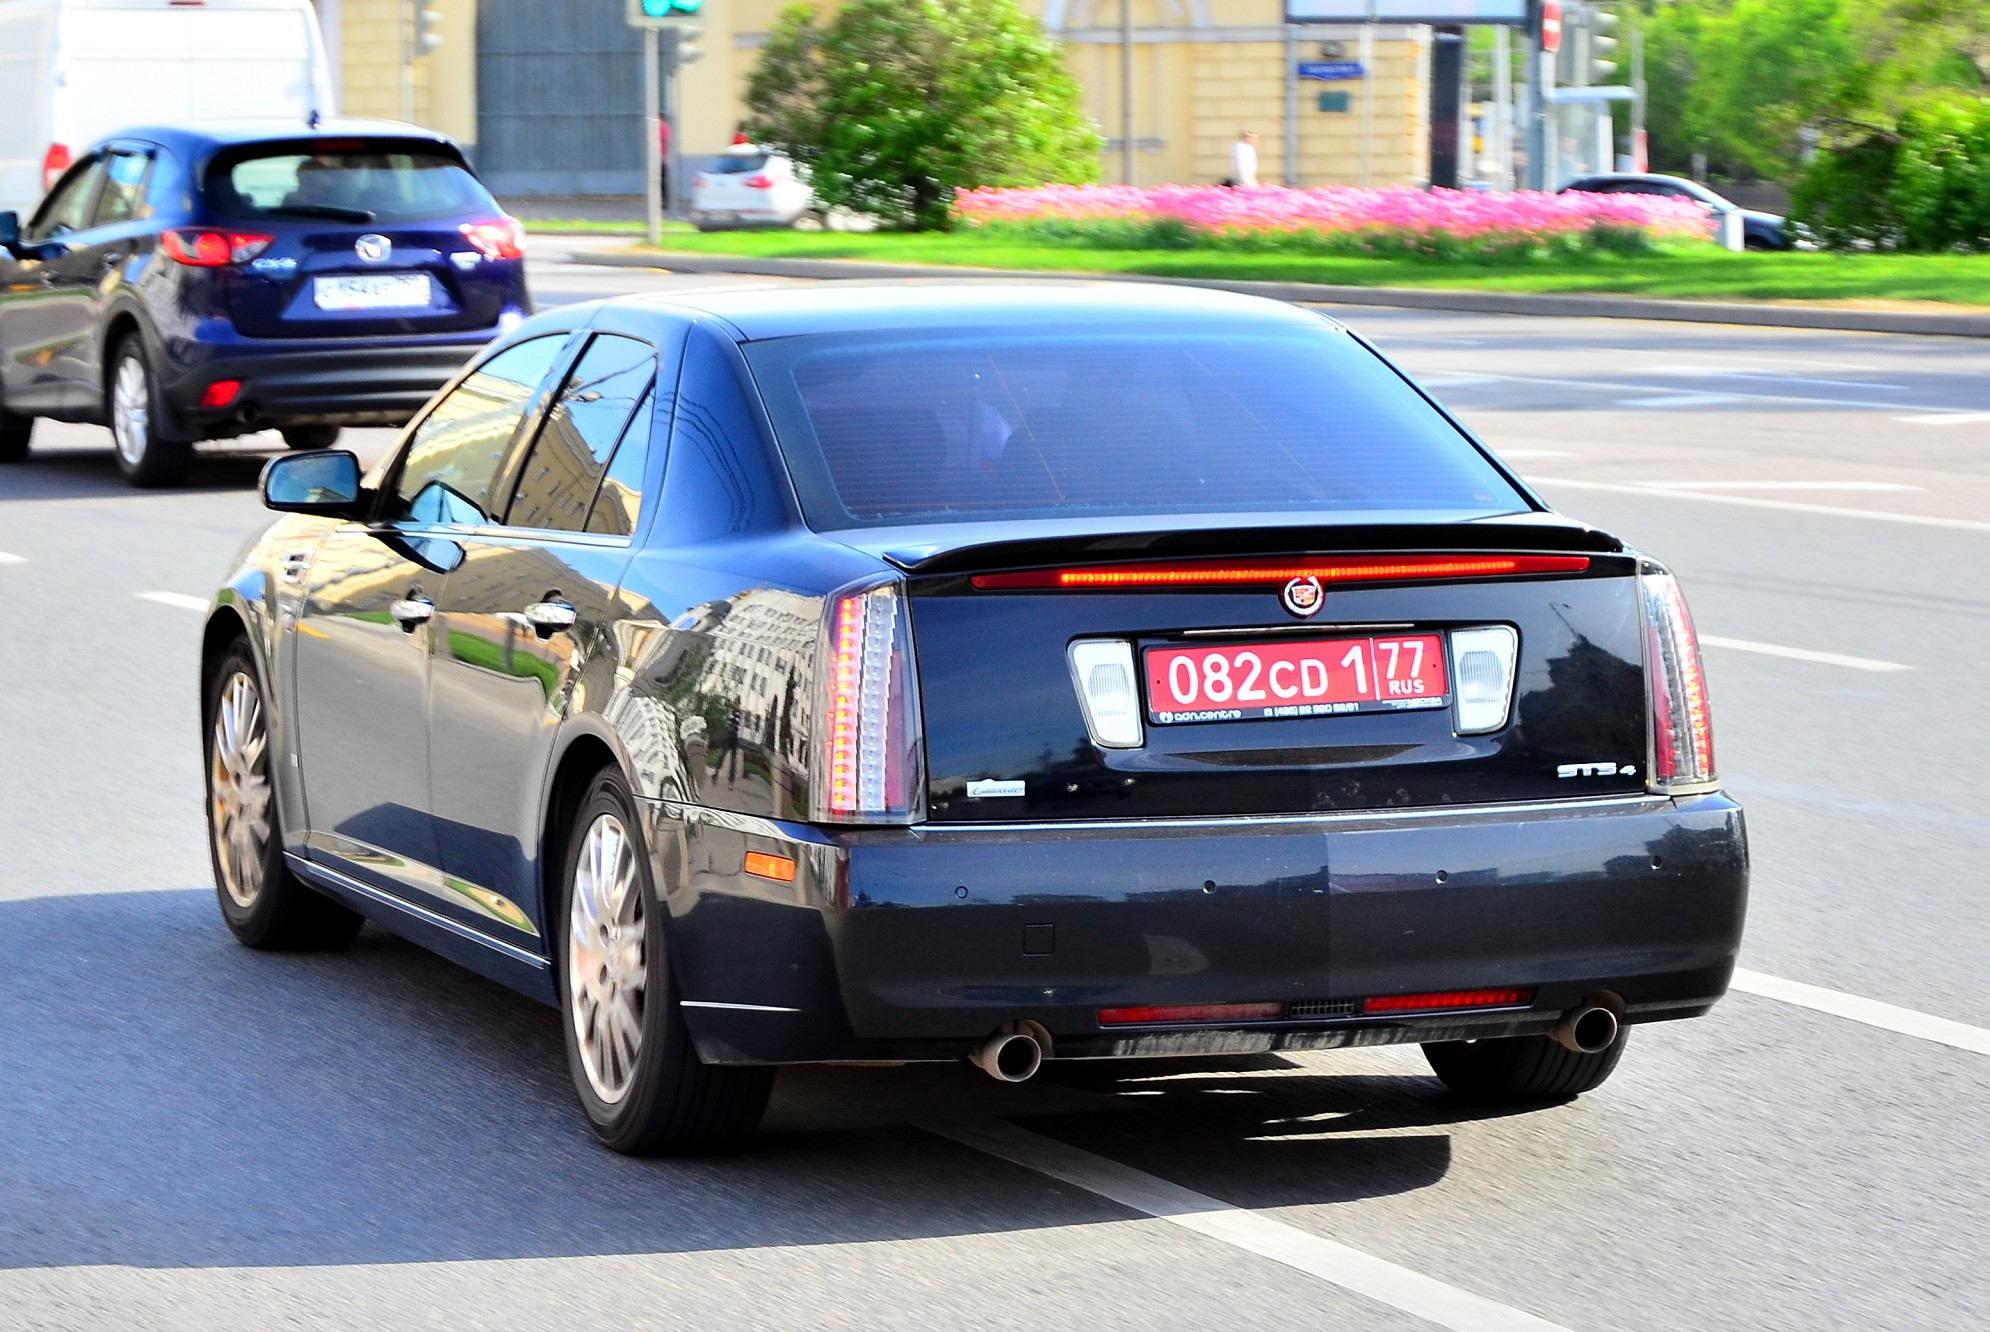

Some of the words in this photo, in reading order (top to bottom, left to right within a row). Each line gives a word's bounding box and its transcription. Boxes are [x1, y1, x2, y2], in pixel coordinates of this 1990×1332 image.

[1378, 640, 1424, 680] 77
[1388, 679, 1425, 695] RUS
[1557, 762, 1617, 778] STS
[1619, 765, 1637, 776] 4
